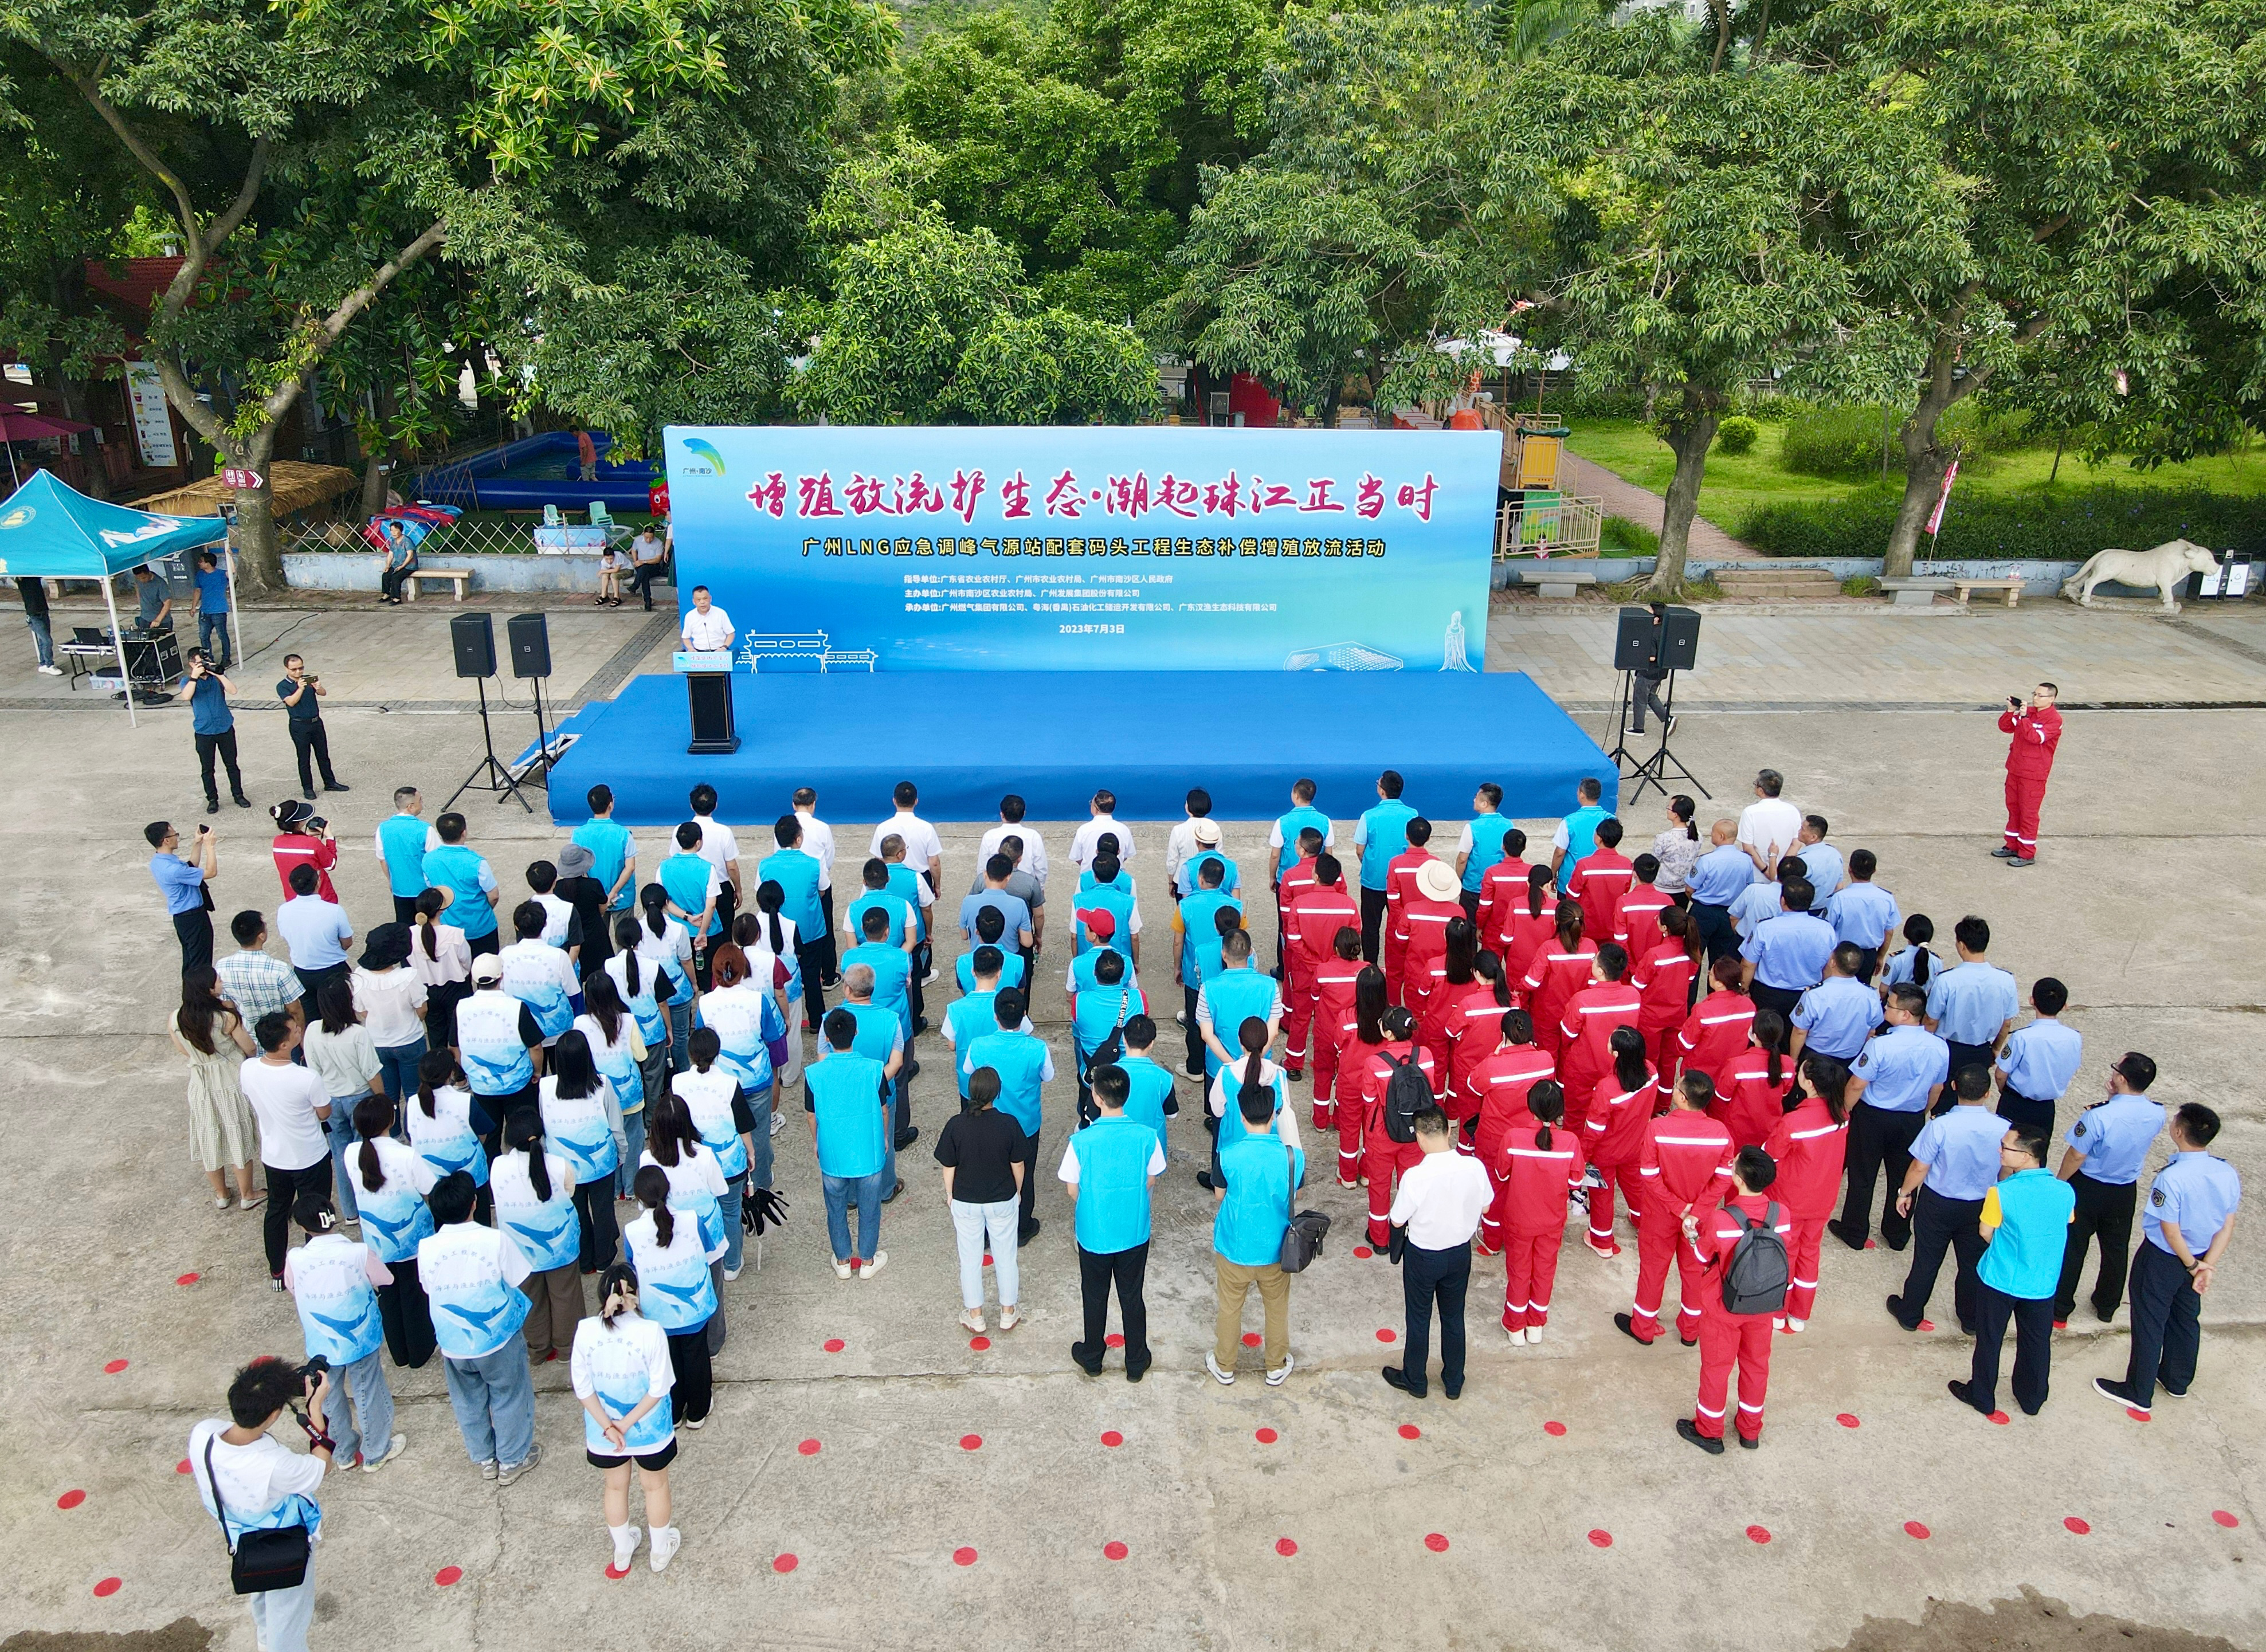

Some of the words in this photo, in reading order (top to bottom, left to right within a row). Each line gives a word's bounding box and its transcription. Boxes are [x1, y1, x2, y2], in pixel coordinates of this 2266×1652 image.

[747, 470, 1440, 524] 增殖放流护生态·潮起珠江正当时
[802, 538, 1386, 557] 广州LNG应急调峰气源站配套码头工程生态补偿增殖放流活动
[1059, 625, 1125, 634] 2023年7月3日
